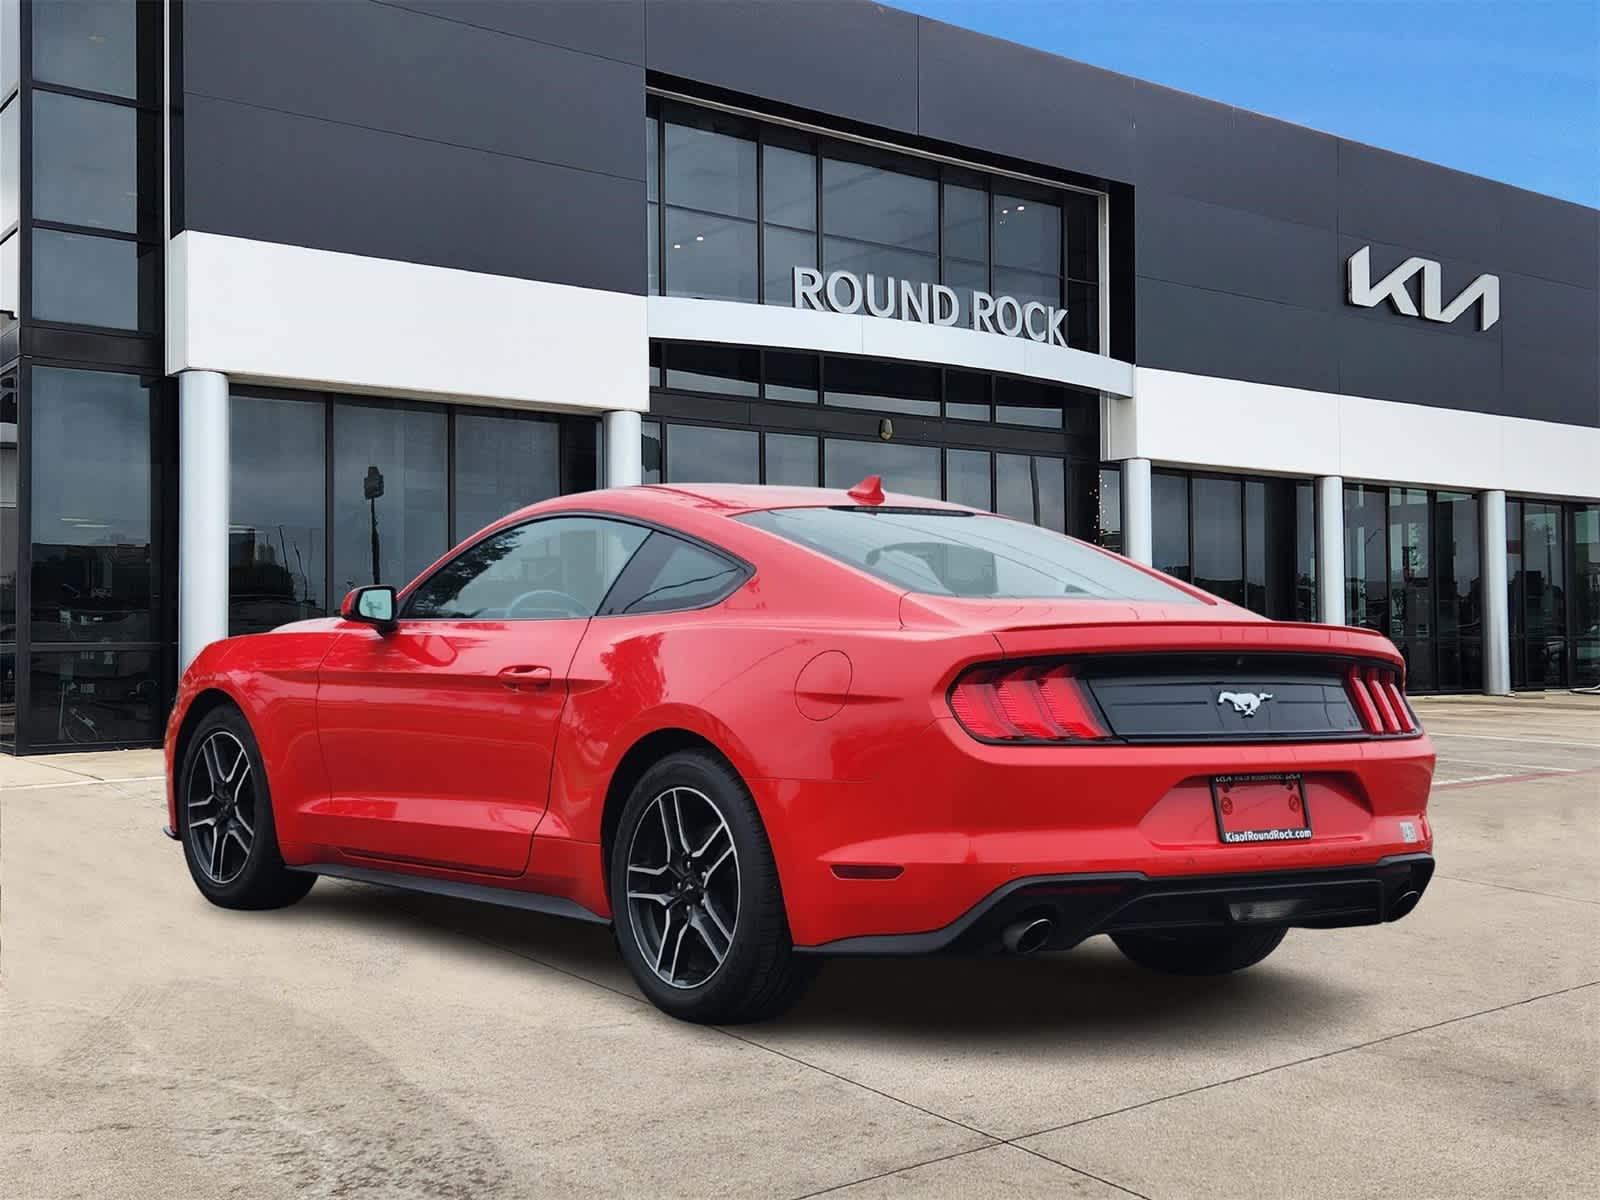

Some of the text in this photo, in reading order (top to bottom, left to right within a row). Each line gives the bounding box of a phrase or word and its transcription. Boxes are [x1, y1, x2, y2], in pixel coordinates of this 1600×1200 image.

[792, 266, 1068, 347] ROUND ROCK
[1347, 245, 1500, 331] KIA
[1225, 829, 1312, 842] KiaofRoundRock.com
